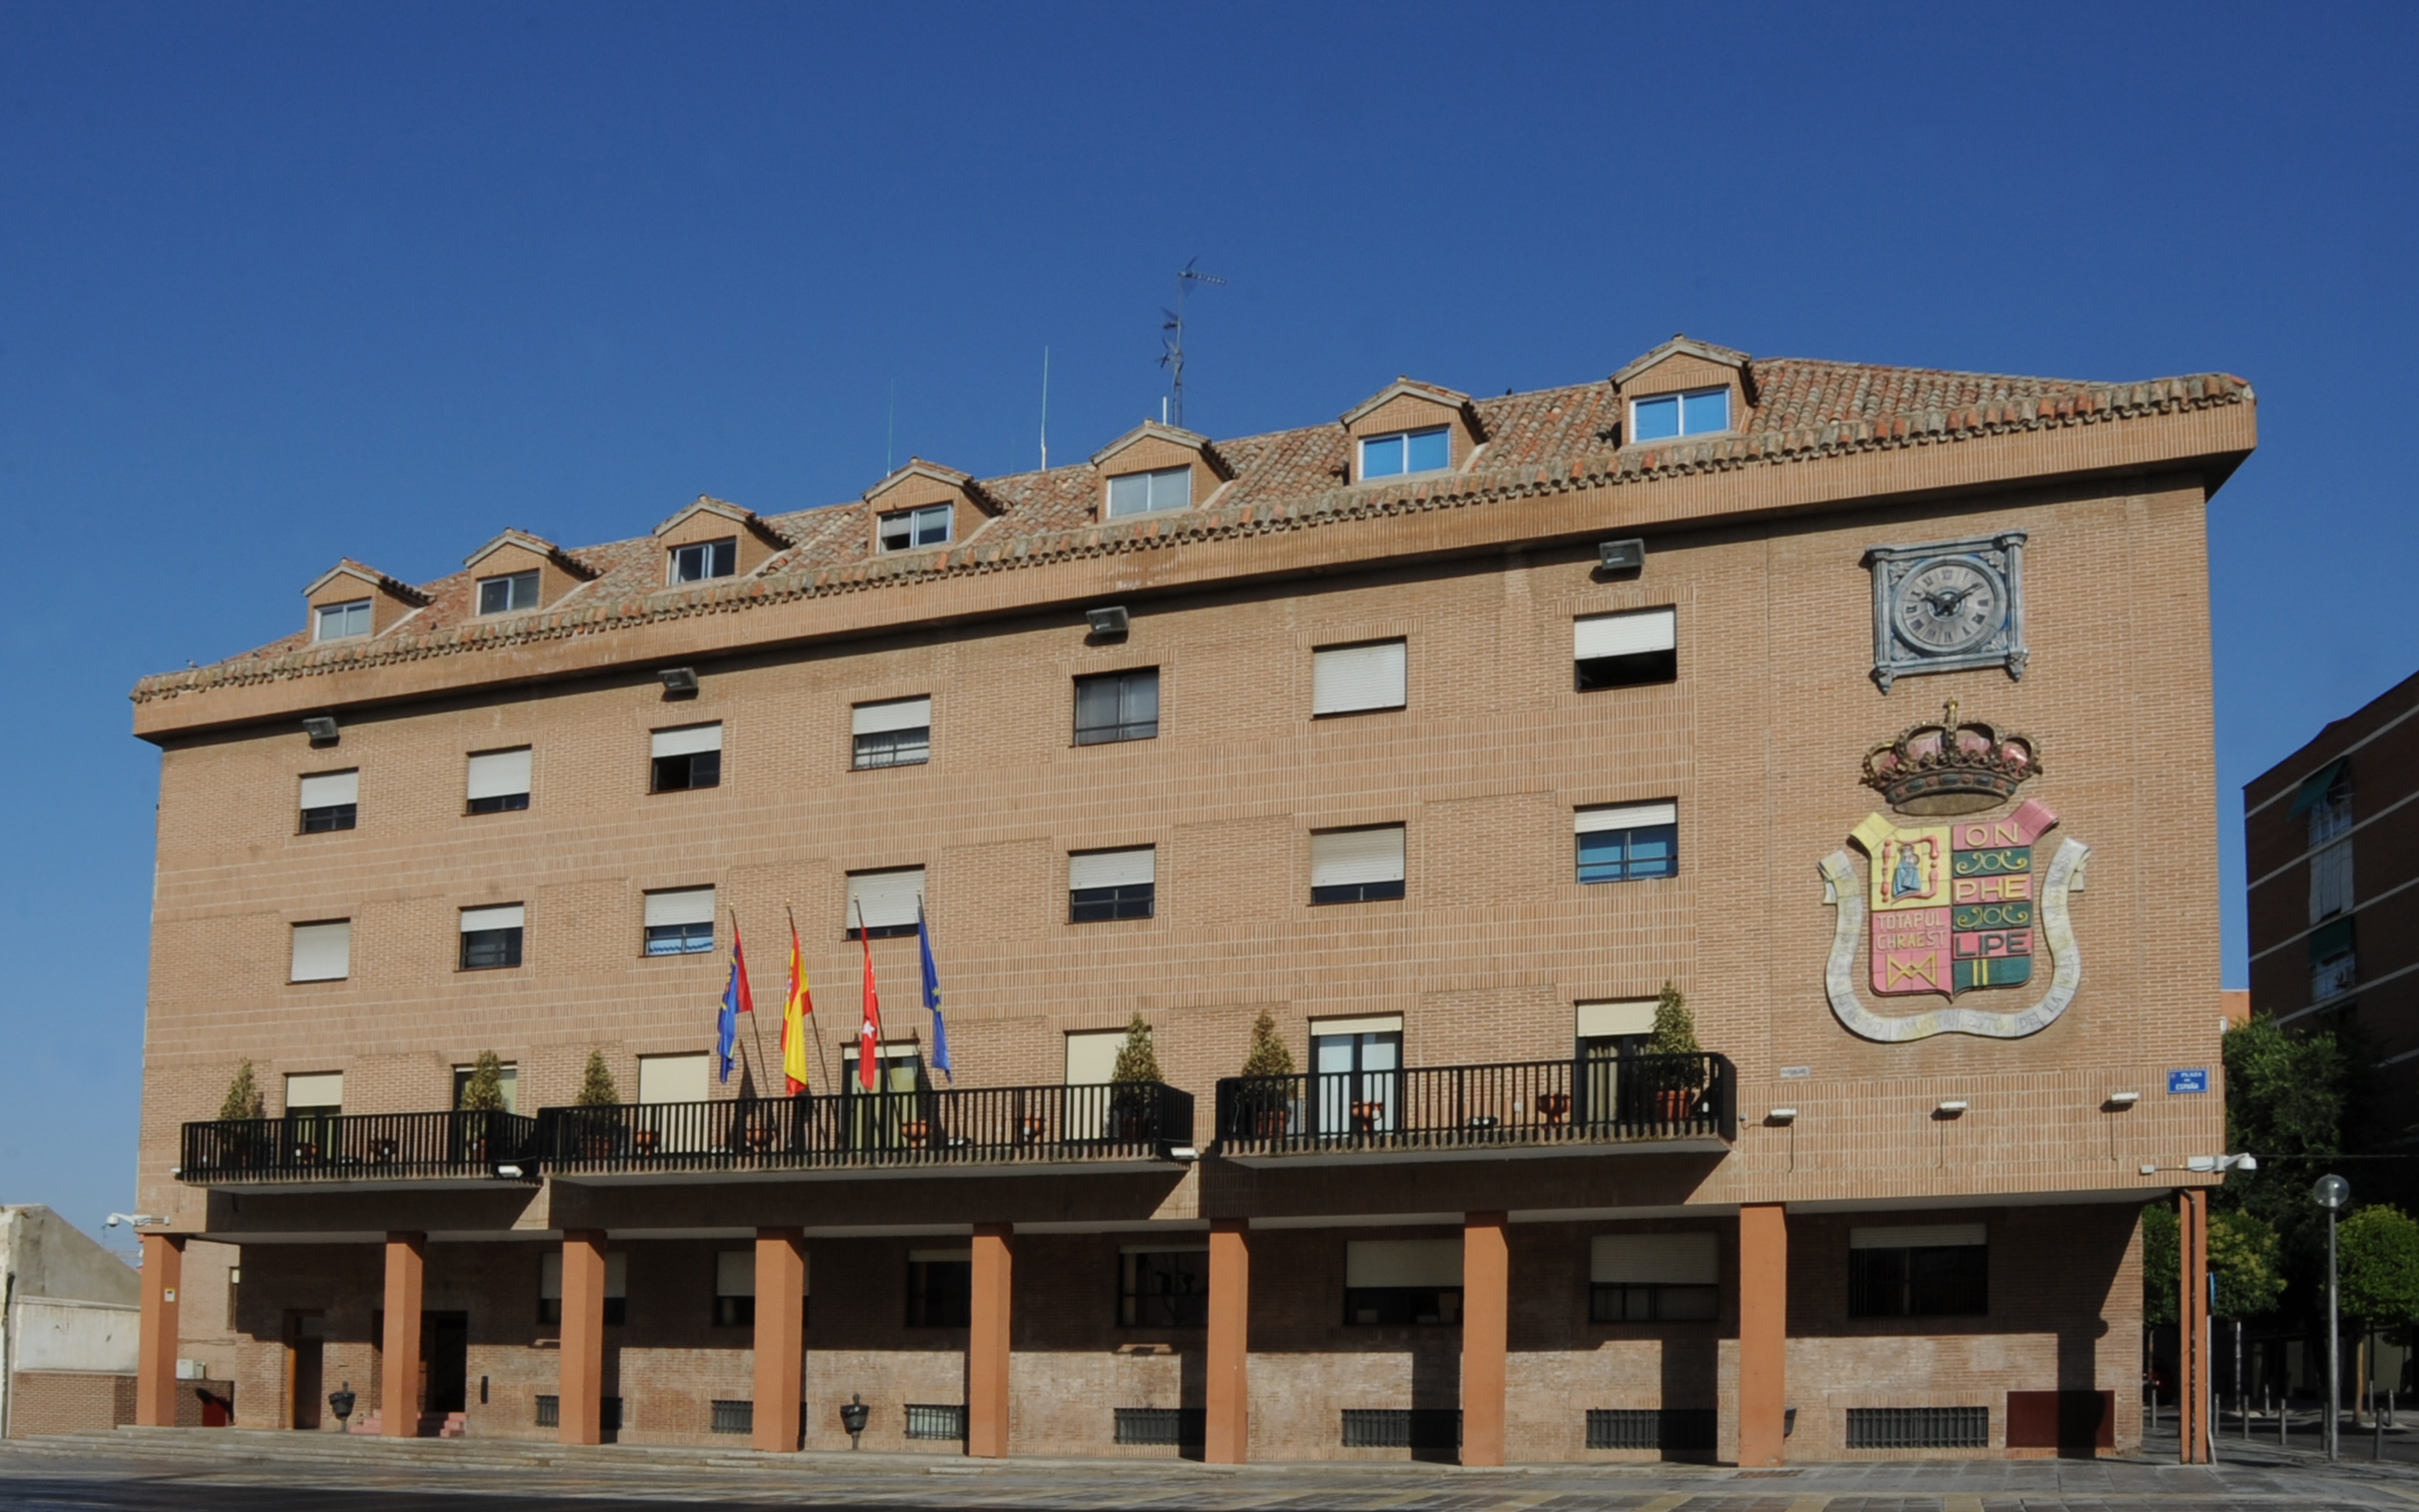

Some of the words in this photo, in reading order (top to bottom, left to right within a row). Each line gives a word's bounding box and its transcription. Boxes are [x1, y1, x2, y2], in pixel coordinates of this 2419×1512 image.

[1965, 822, 2019, 847] ON
[1956, 876, 2027, 902] PHE
[1956, 931, 2028, 957] LIPE
[2019, 1015, 2039, 1029] DE
[2044, 996, 2063, 1013] LA
[2175, 1082, 2199, 1090] ESPAÑA
